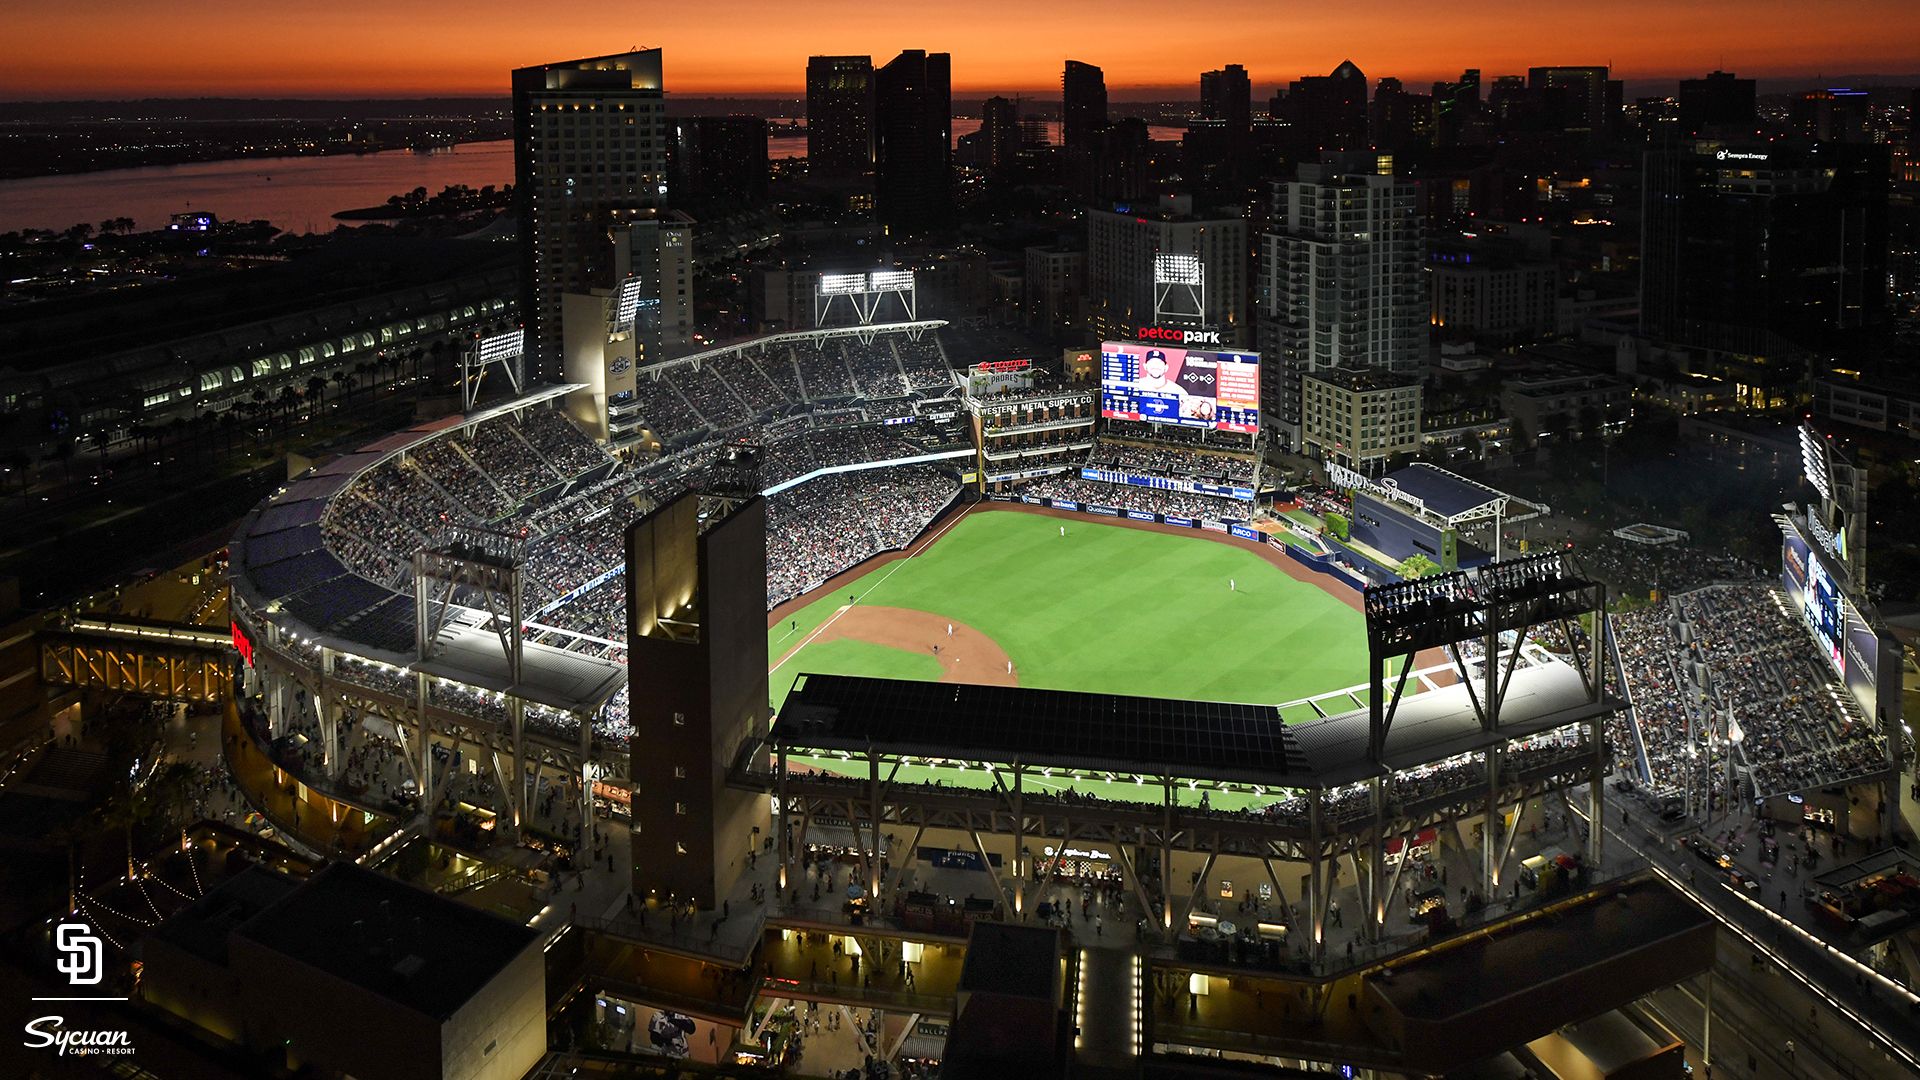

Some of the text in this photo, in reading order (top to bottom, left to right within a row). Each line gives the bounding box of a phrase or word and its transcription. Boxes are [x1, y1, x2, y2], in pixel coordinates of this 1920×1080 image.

[1749, 152, 1768, 160] Energy
[993, 359, 1028, 368] TOYOTA
[991, 373, 1018, 385] PADRES
[981, 396, 1094, 415] WESTERN METAL SUPPLY CO.
[1087, 505, 1118, 515] Qualcomm
[1128, 510, 1154, 521] GEICO
[1232, 528, 1251, 538] ARCO
